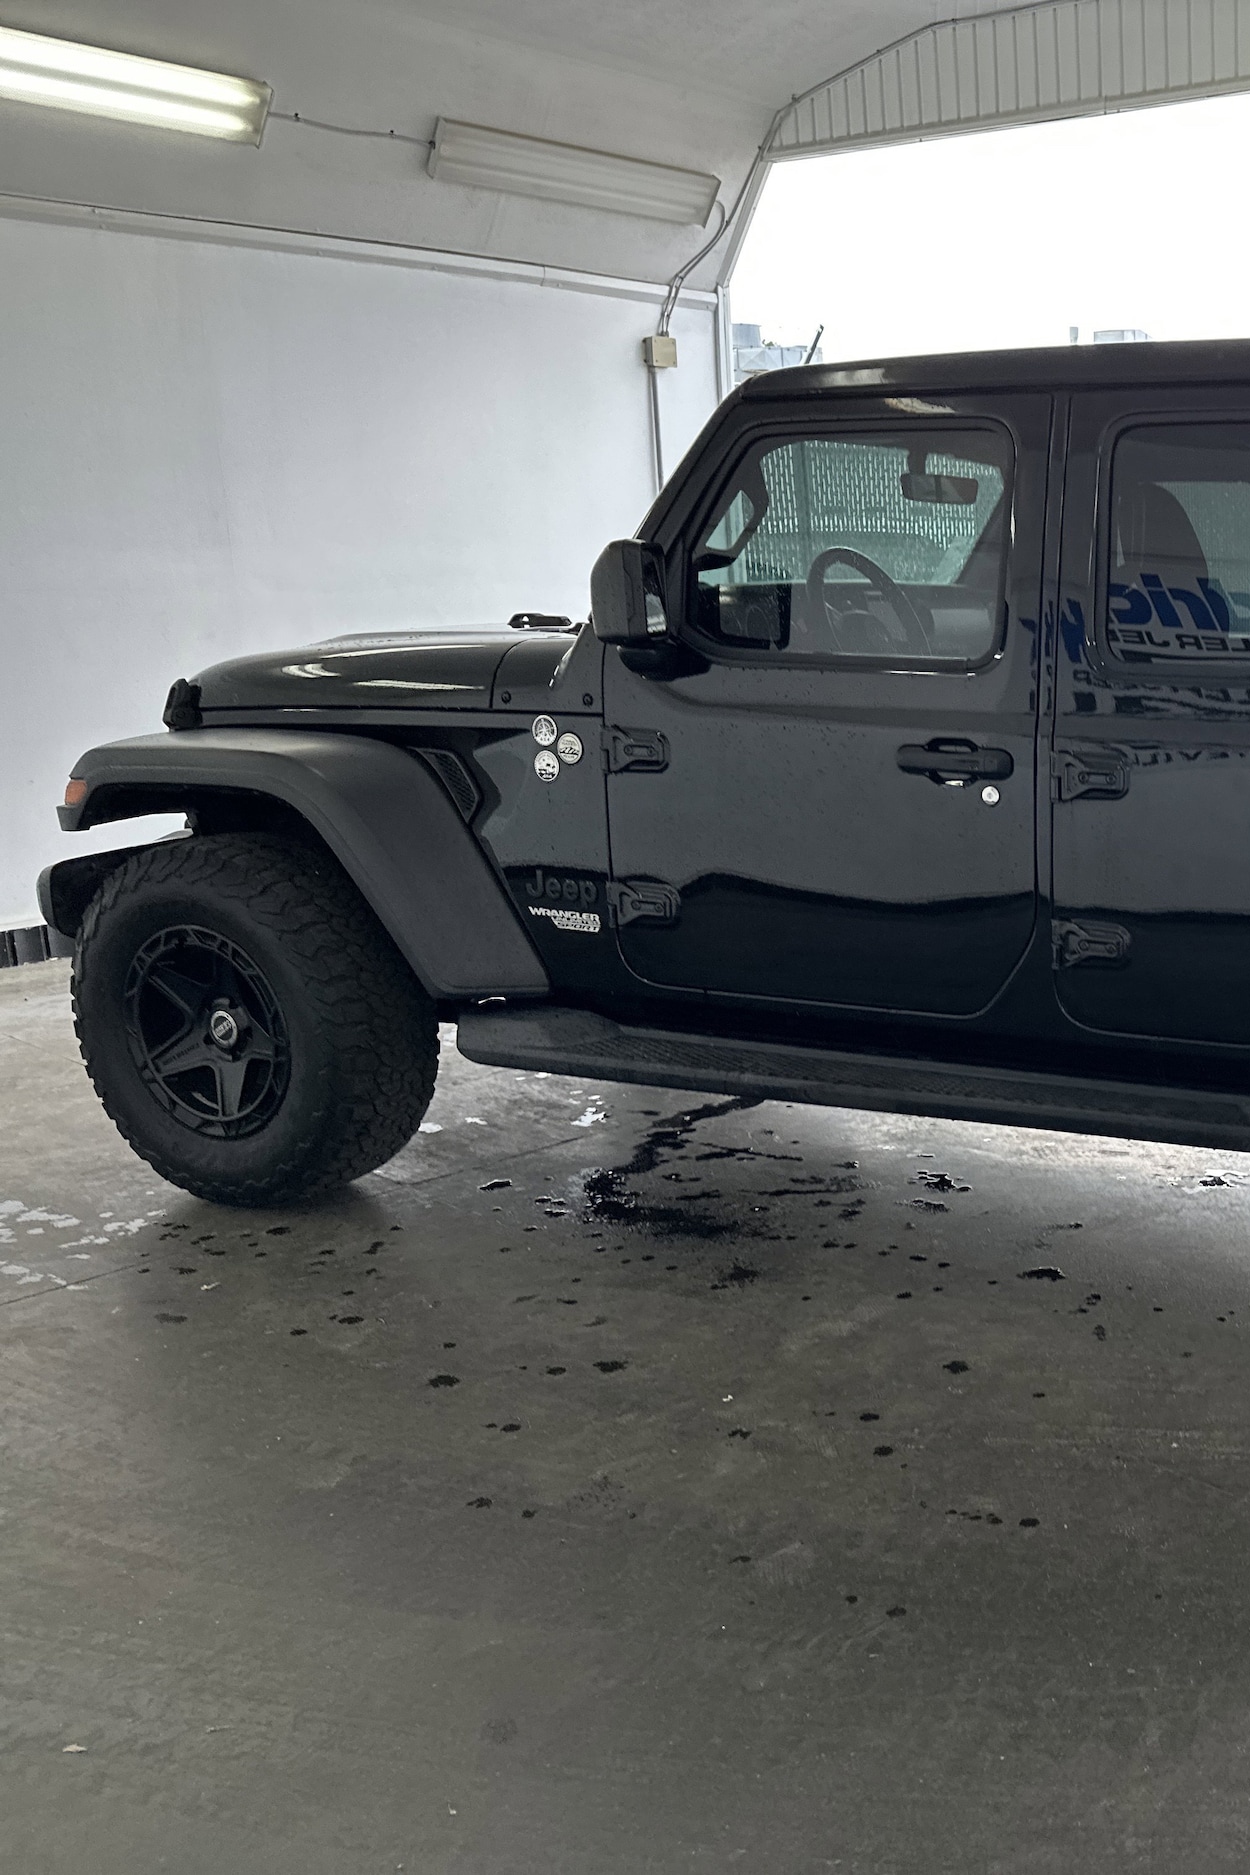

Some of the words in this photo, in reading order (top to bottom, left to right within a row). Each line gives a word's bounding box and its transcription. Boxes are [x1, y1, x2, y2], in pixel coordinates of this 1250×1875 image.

[525, 869, 597, 909] Jeep
[528, 905, 600, 922] WRANGLER
[556, 921, 598, 931] SPORT
